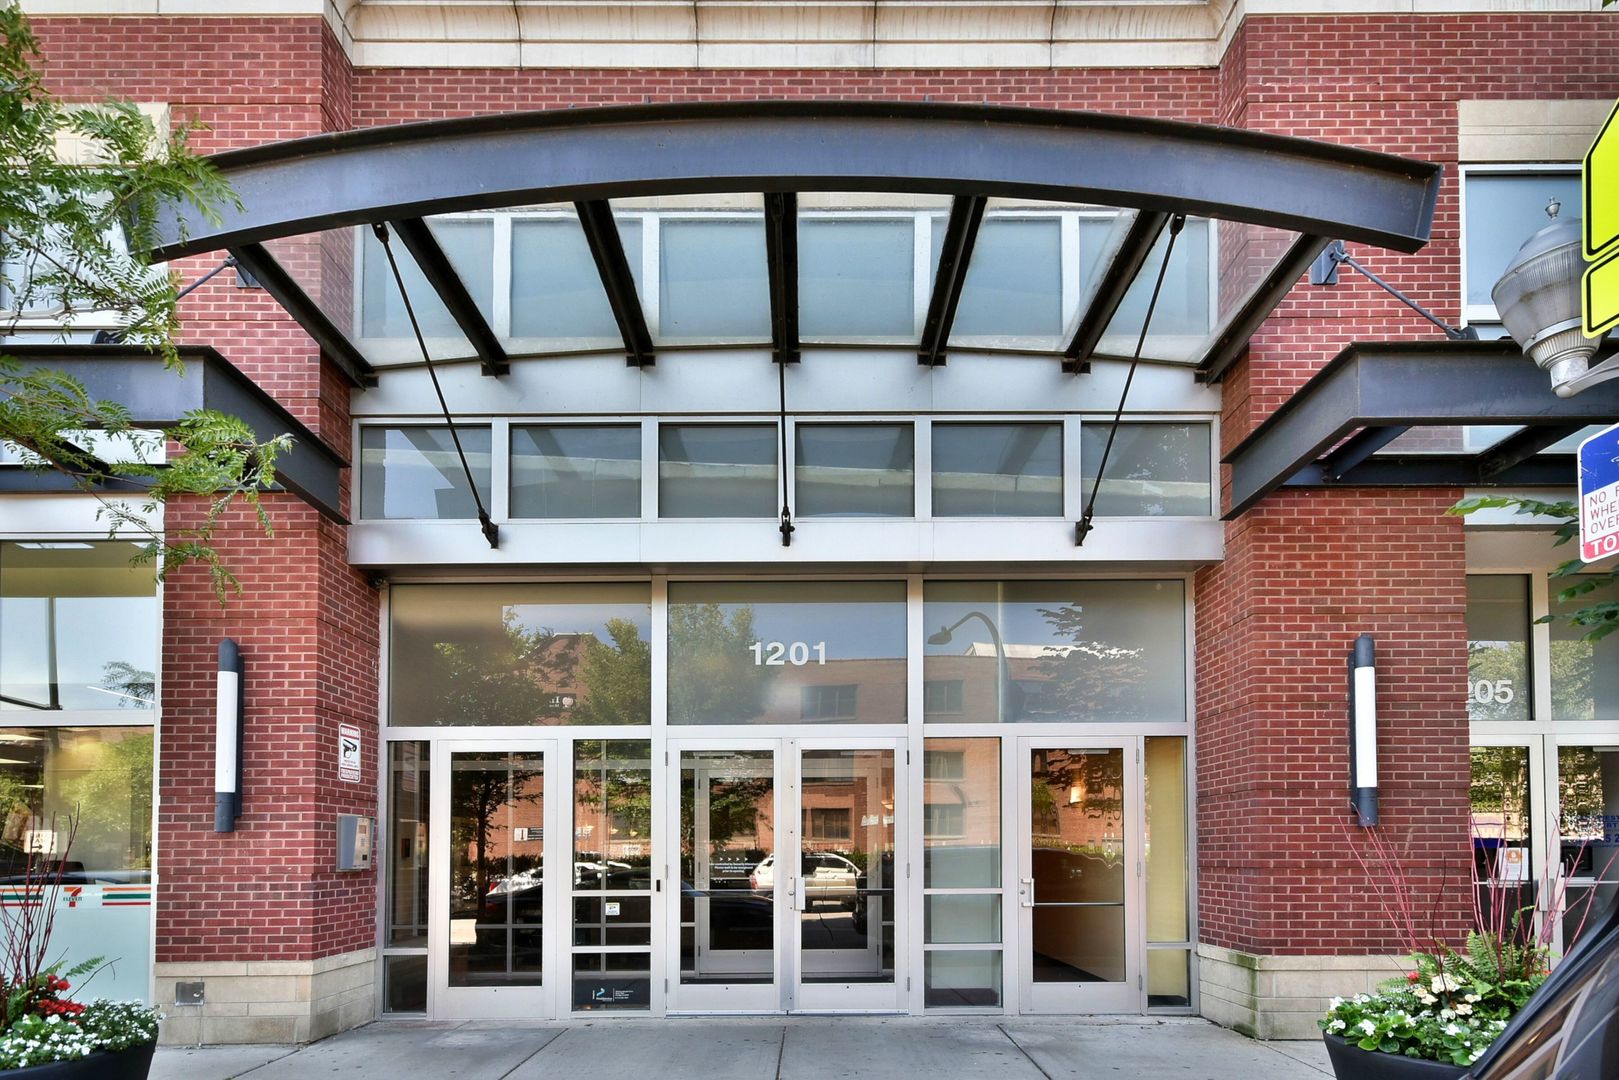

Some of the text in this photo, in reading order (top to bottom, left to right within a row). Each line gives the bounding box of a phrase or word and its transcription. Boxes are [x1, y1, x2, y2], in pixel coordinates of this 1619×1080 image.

[1590, 491, 1607, 507] NO
[1591, 514, 1619, 534] OVE
[1591, 533, 1619, 555] TO
[748, 641, 826, 666] 1201
